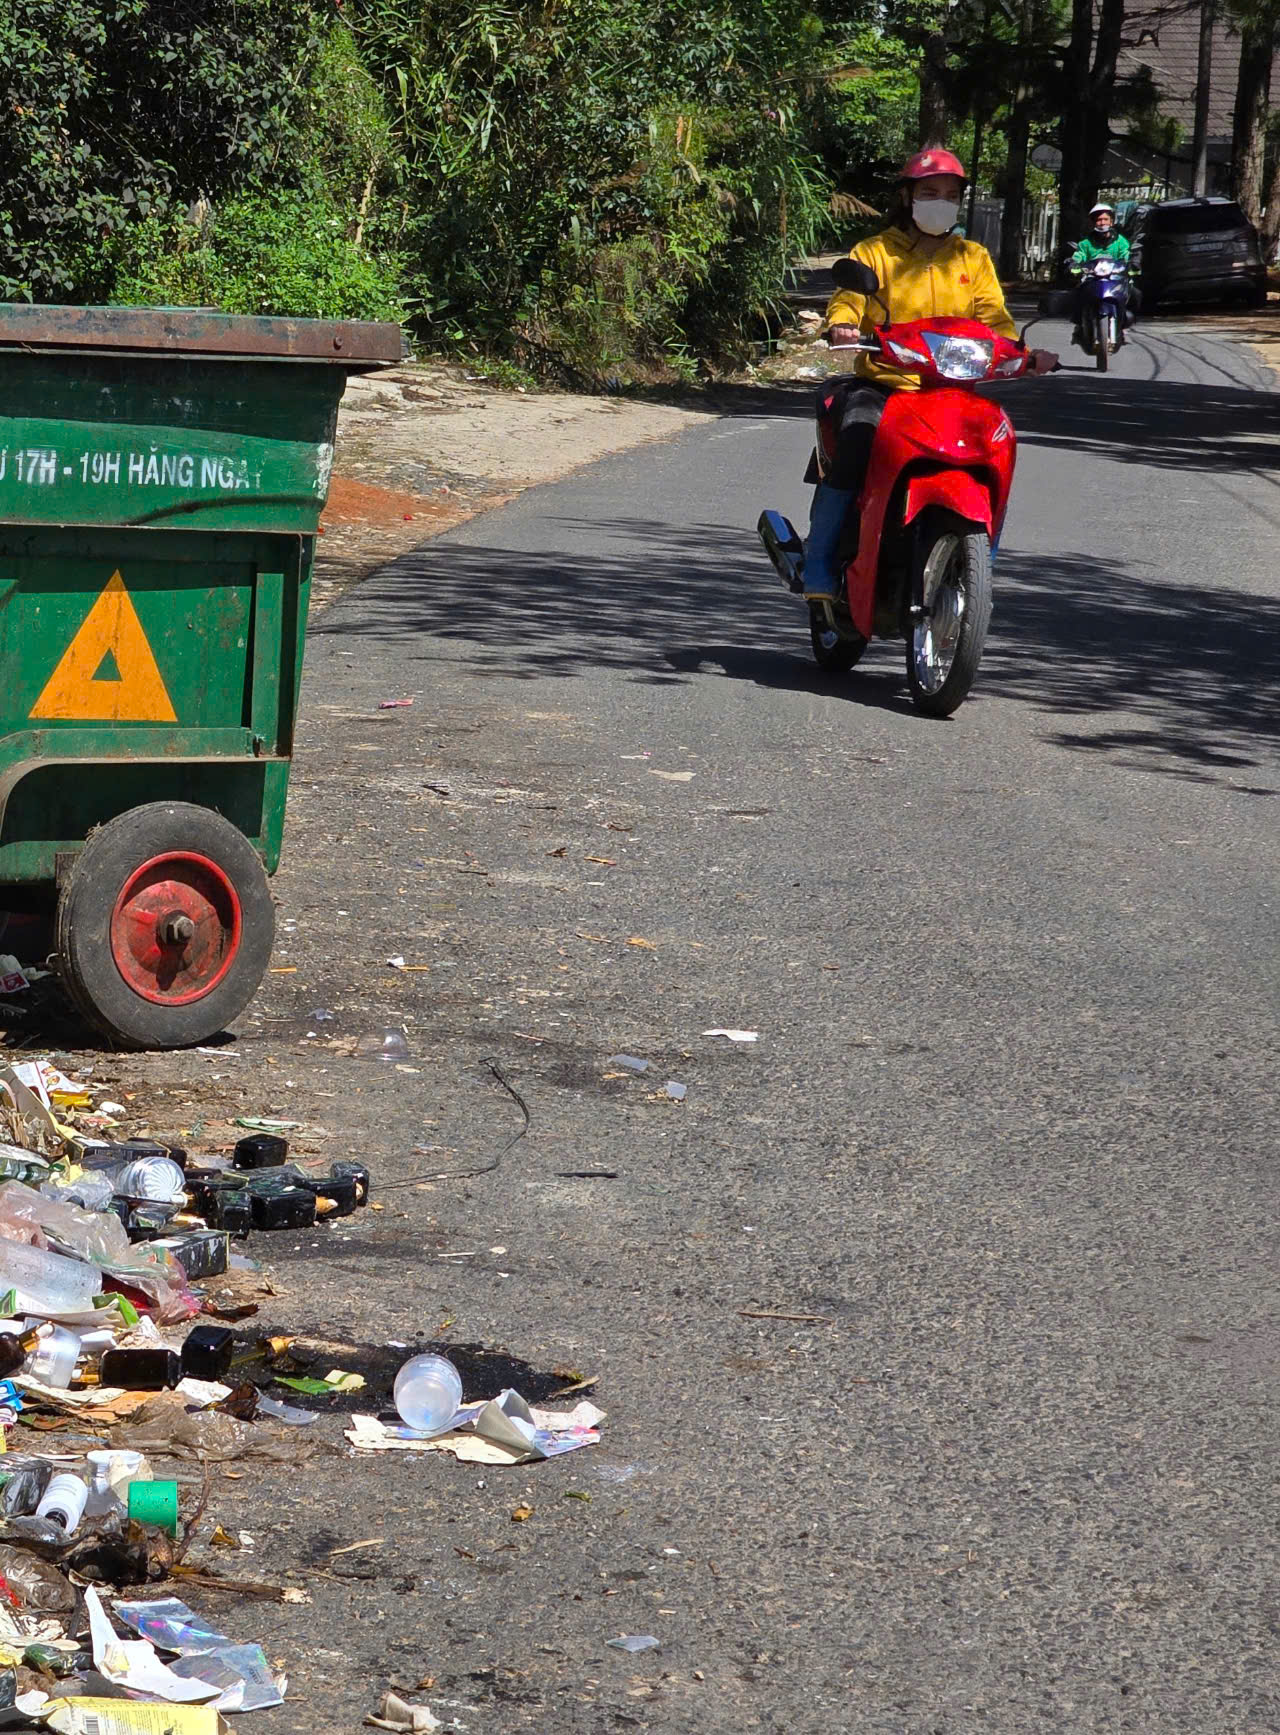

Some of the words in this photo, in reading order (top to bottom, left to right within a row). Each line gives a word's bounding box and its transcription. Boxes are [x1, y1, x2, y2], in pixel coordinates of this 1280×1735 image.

[15, 449, 56, 484] 17H
[63, 466, 72, 475] -
[80, 451, 121, 484] 19H
